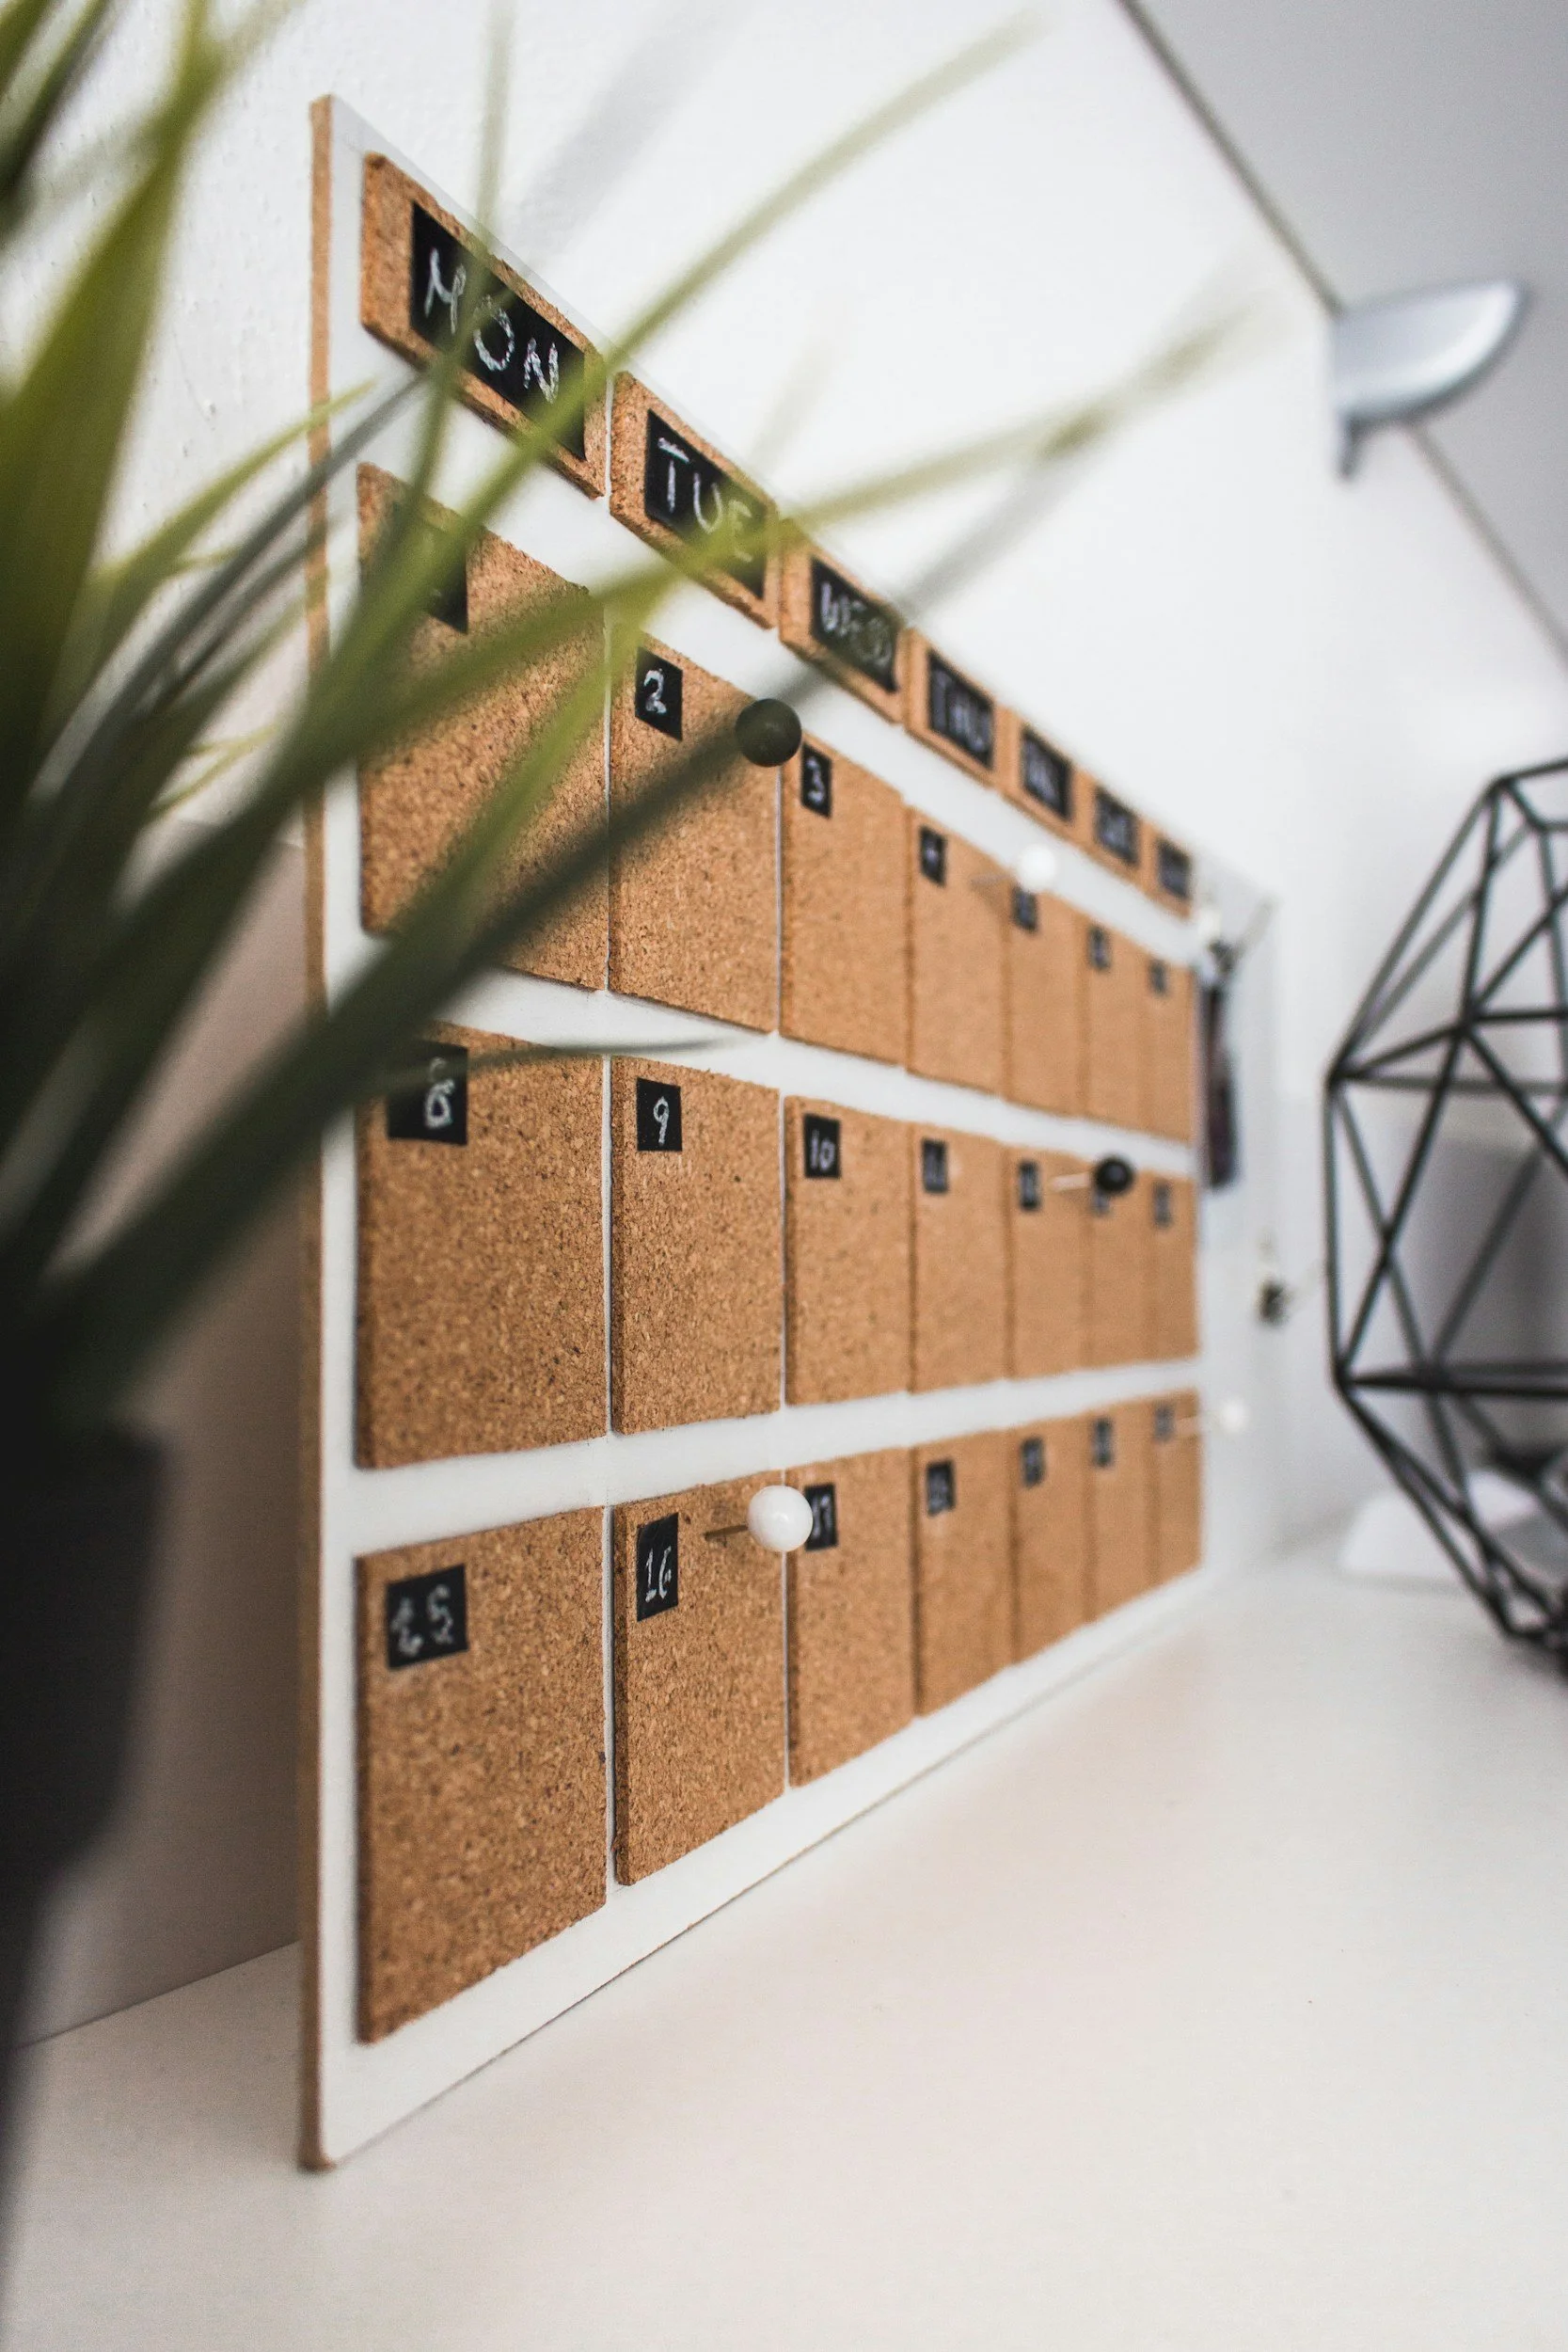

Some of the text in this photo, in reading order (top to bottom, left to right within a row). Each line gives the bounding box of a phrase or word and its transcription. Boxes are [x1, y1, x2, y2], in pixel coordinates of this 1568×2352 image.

[425, 246, 560, 405] MON
[643, 668, 667, 714] 2
[653, 1096, 670, 1146] 9
[810, 1129, 835, 1171] 10
[644, 1545, 673, 1603] 16
